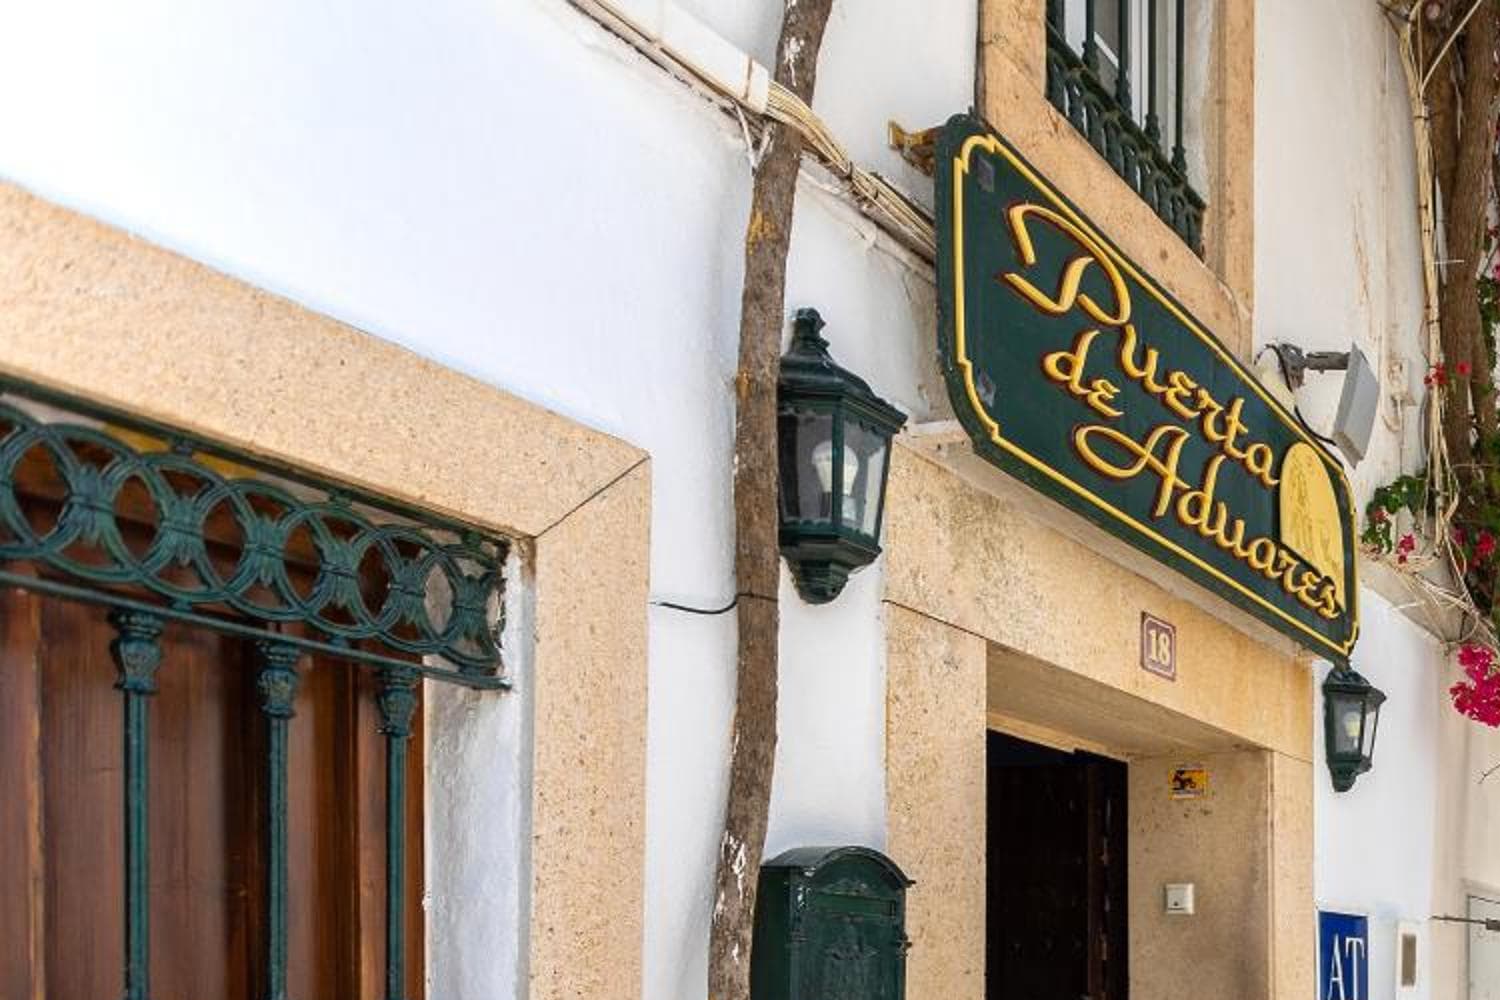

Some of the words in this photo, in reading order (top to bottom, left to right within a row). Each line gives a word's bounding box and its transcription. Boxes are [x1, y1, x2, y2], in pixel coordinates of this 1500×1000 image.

[1004, 204, 1279, 485] Puerta
[1043, 331, 1124, 418] de
[1073, 423, 1341, 620] Aduares
[1148, 629, 1170, 666] 18
